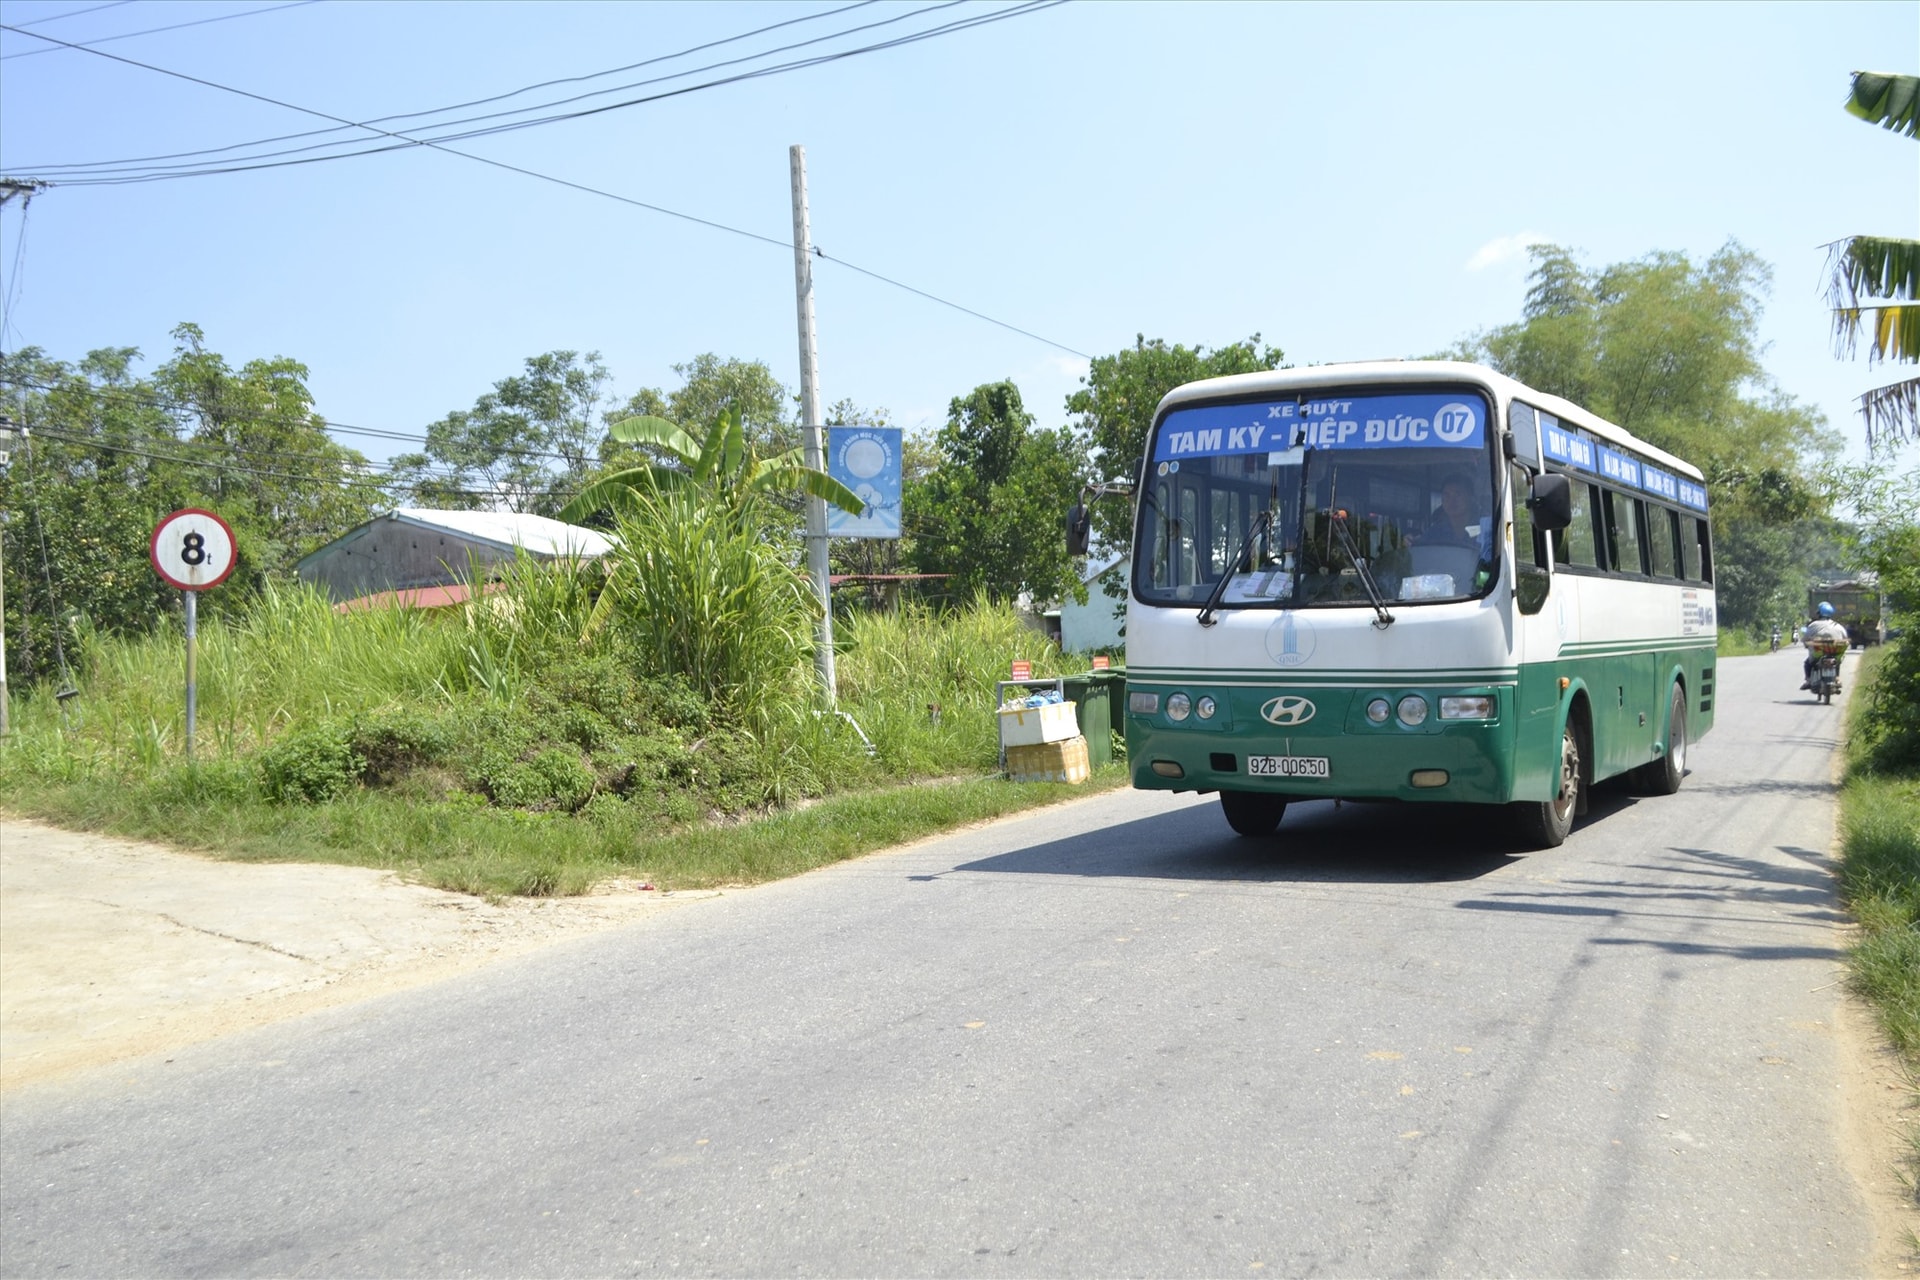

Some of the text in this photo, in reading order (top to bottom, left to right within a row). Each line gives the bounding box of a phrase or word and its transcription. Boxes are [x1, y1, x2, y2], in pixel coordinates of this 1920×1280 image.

[1267, 400, 1352, 418] XE BUÝT
[1441, 410, 1469, 434] 07
[1169, 428, 1222, 454] TAM
[1228, 421, 1266, 449] KỲ
[1364, 414, 1429, 443] ĐỨC
[1250, 758, 1326, 776] 92B-006.50
